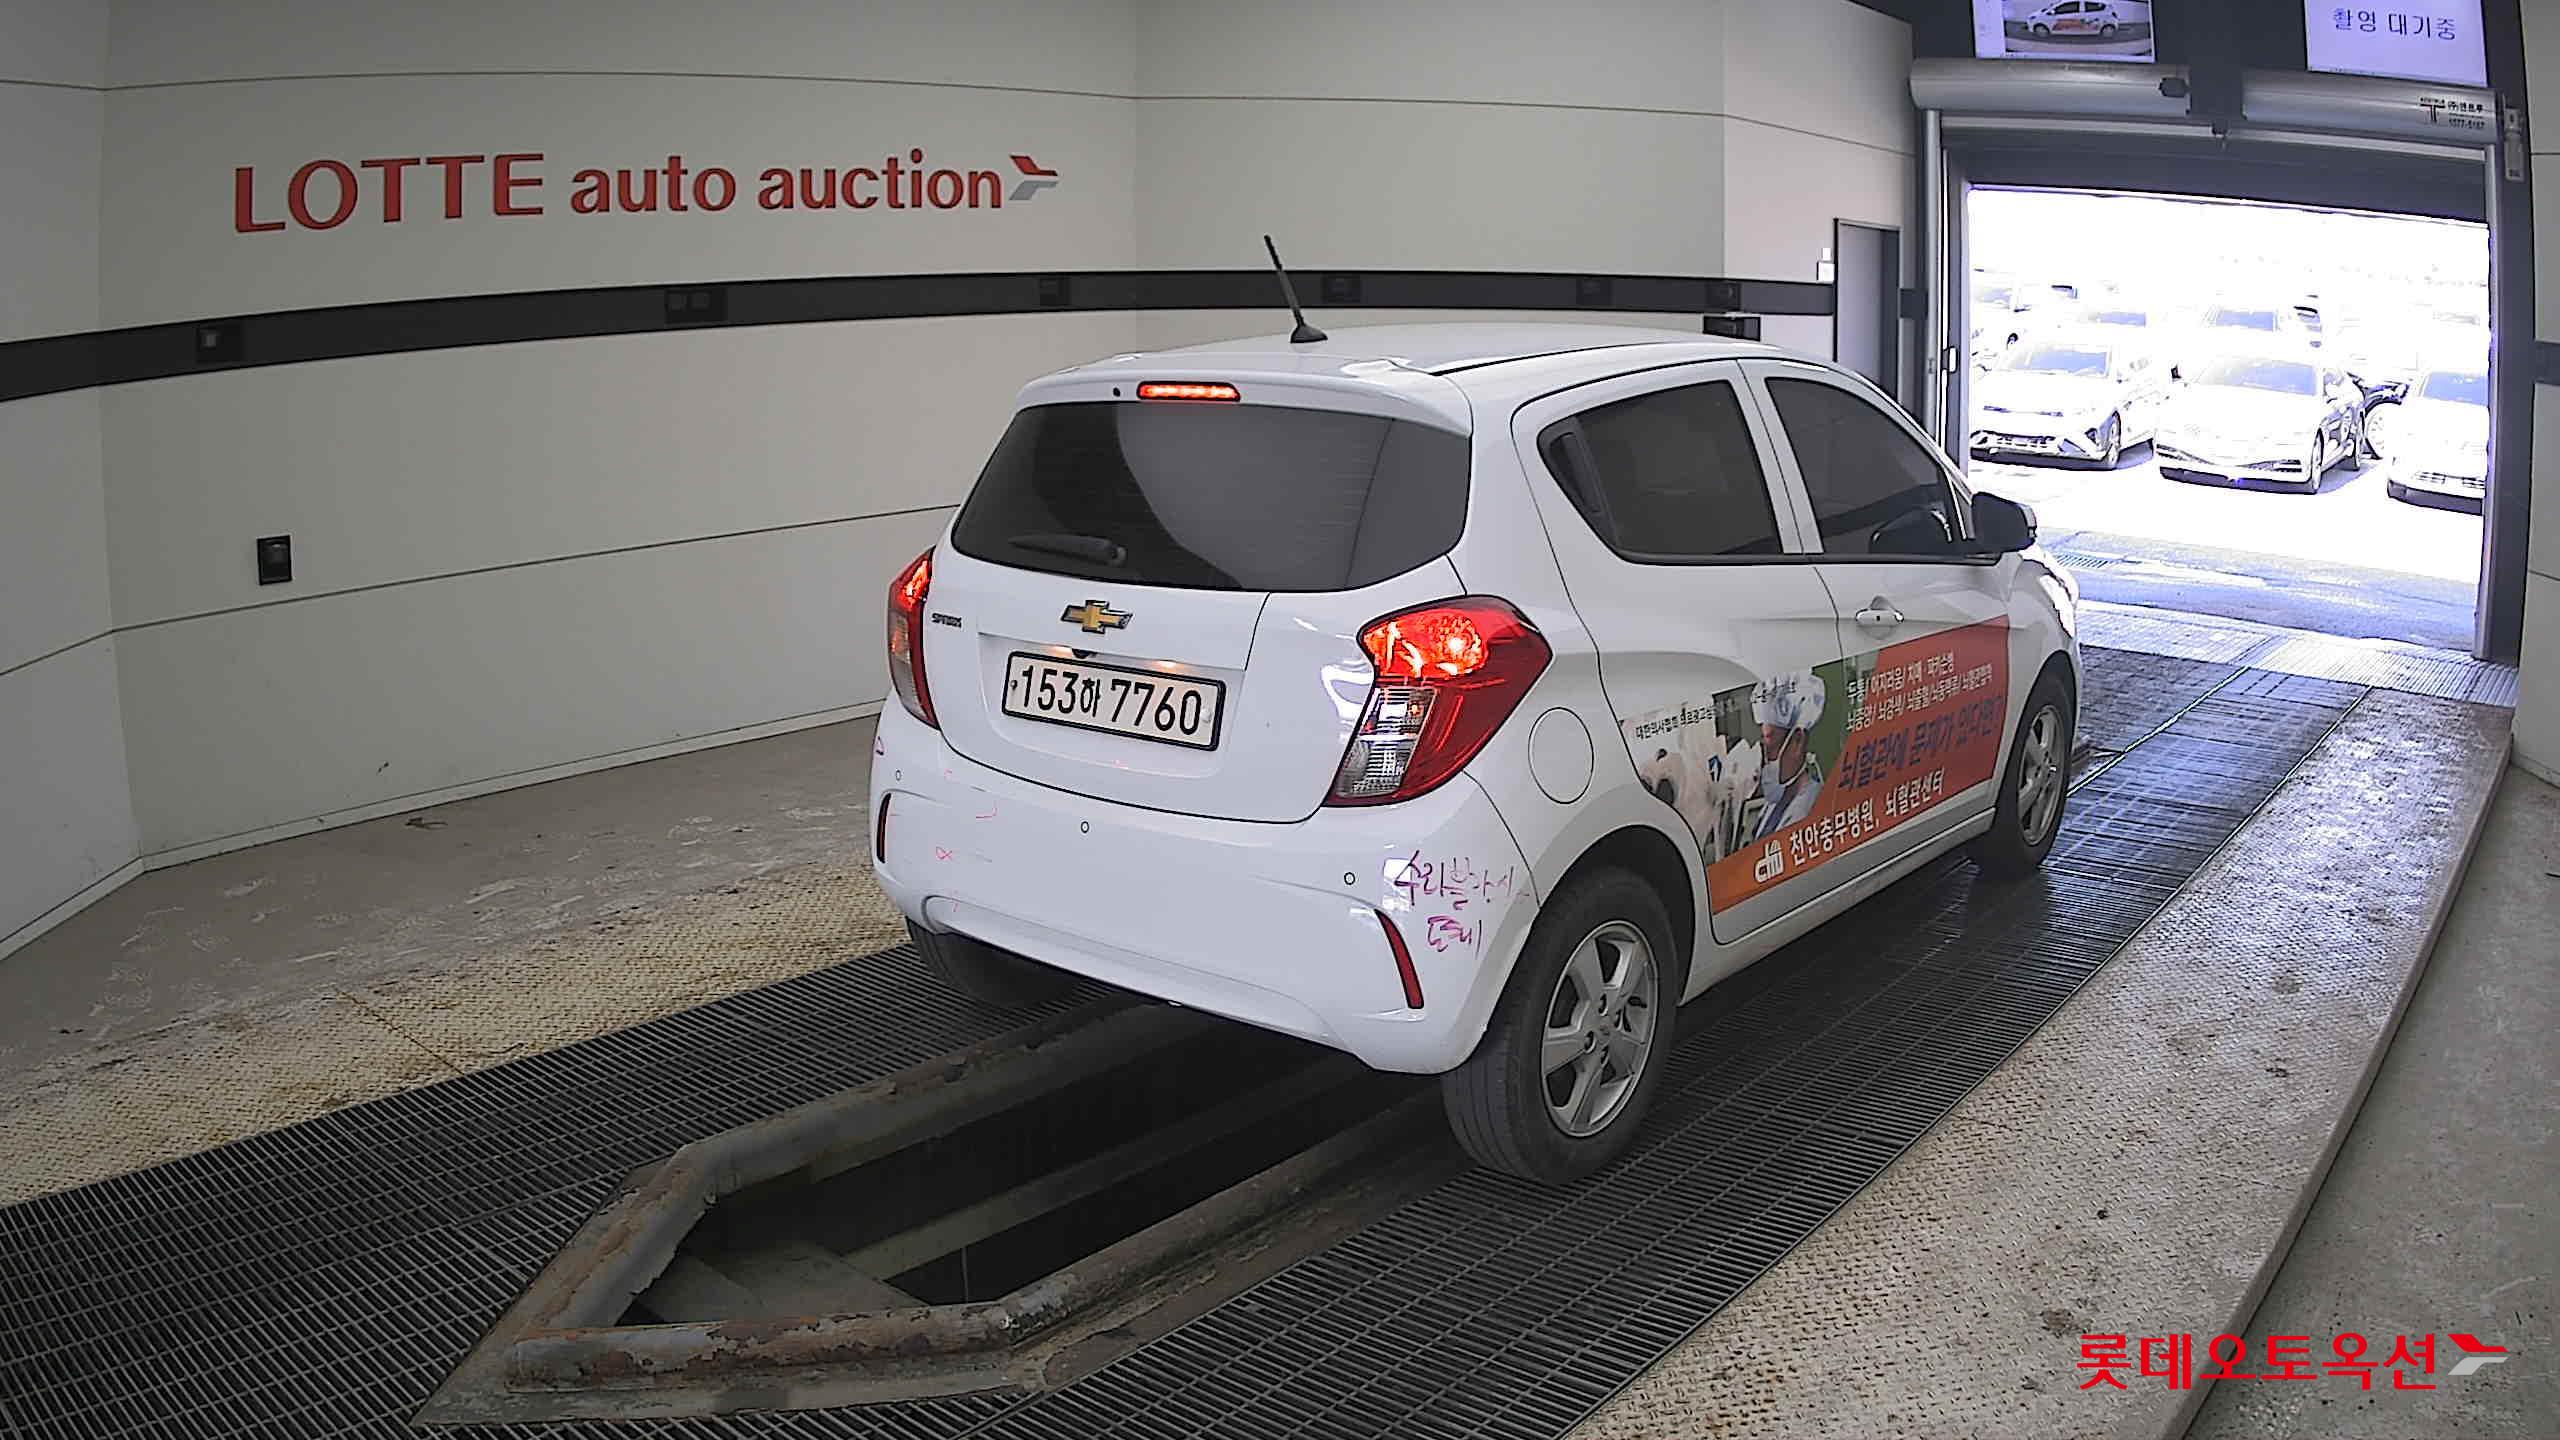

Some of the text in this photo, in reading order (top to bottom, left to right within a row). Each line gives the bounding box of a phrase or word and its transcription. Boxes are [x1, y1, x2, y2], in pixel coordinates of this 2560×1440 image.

[2333, 8, 2456, 41] 촬영 대기중
[234, 147, 1003, 233] LOTTE auto auction
[1021, 664, 1202, 735] 153하 7760
[1838, 726, 1910, 788] 뇌혈관에
[1885, 766, 1945, 818] 뇌혈관센터
